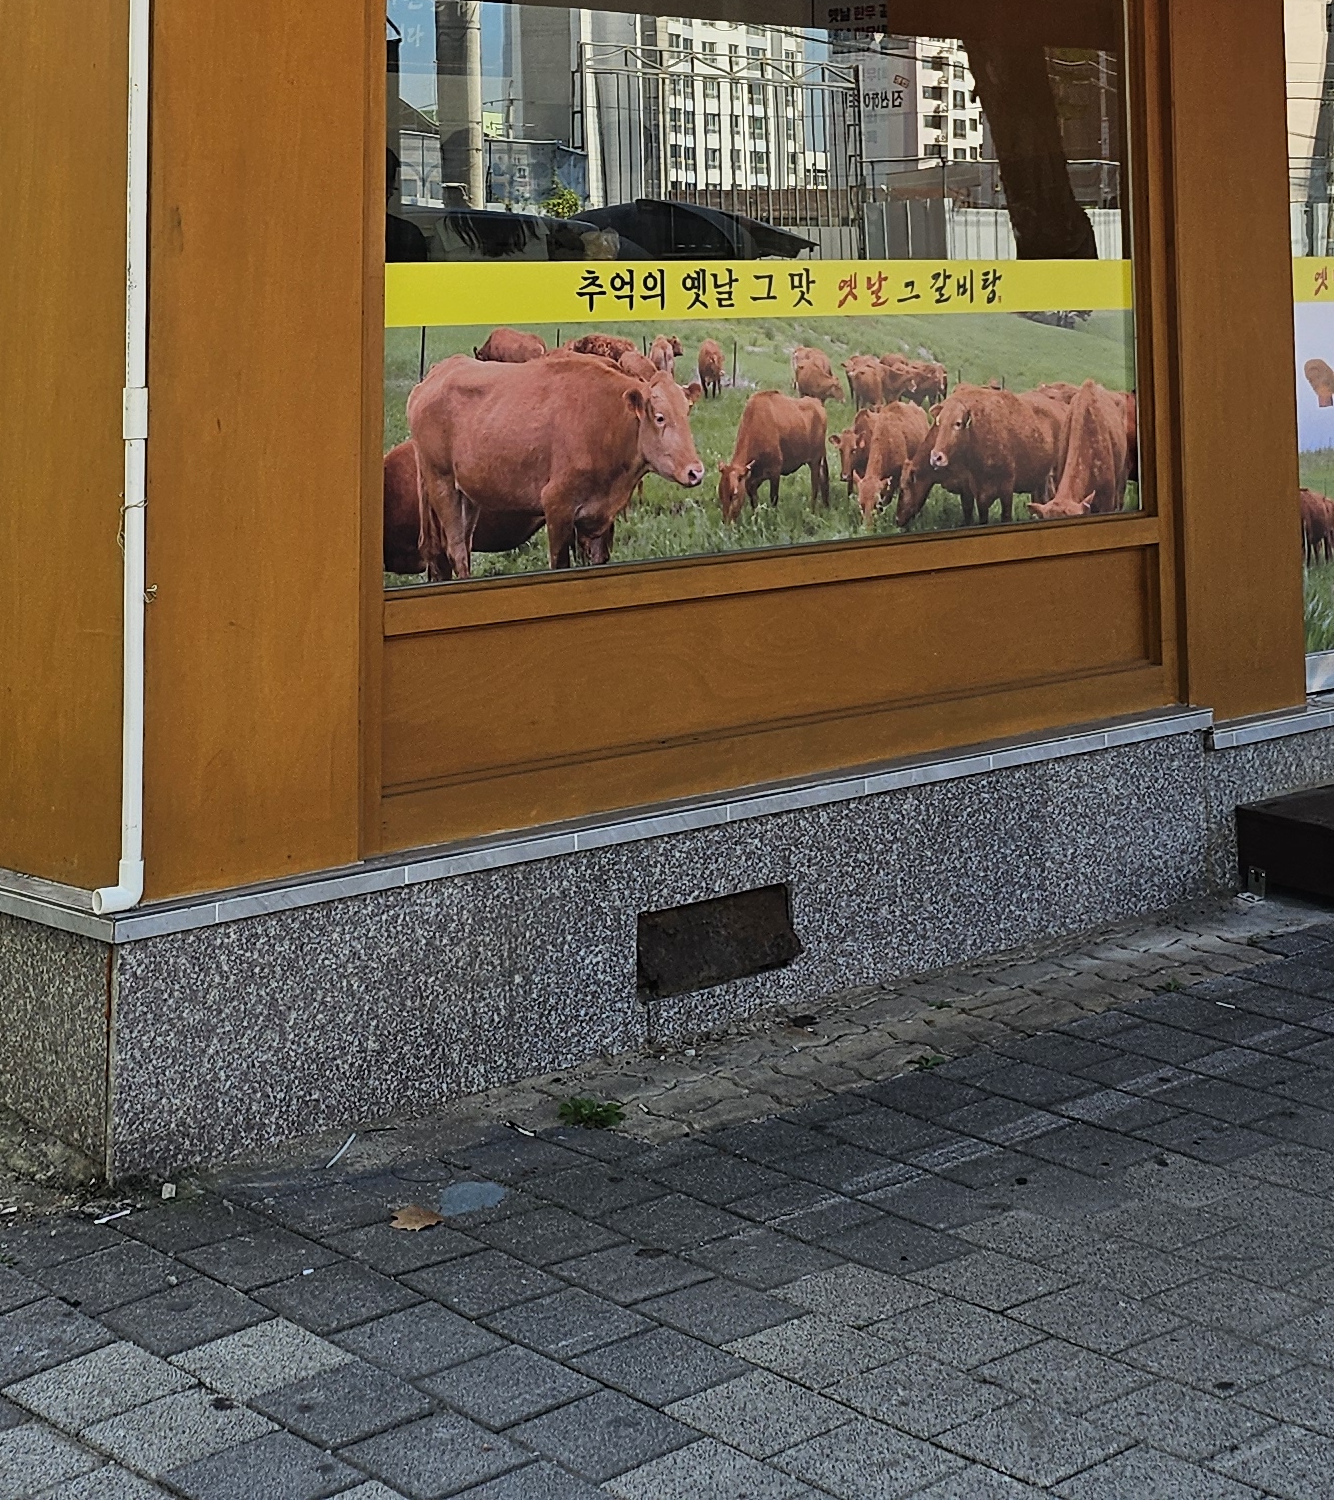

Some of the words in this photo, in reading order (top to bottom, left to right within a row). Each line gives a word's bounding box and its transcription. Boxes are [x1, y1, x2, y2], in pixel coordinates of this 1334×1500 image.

[574, 268, 666, 313] 추억의
[681, 267, 739, 309] 옛날
[749, 273, 778, 301] 그
[787, 267, 817, 308] 맛
[836, 271, 889, 309] 옛날
[896, 280, 921, 300] 그
[928, 268, 1001, 305] 갈비탕
